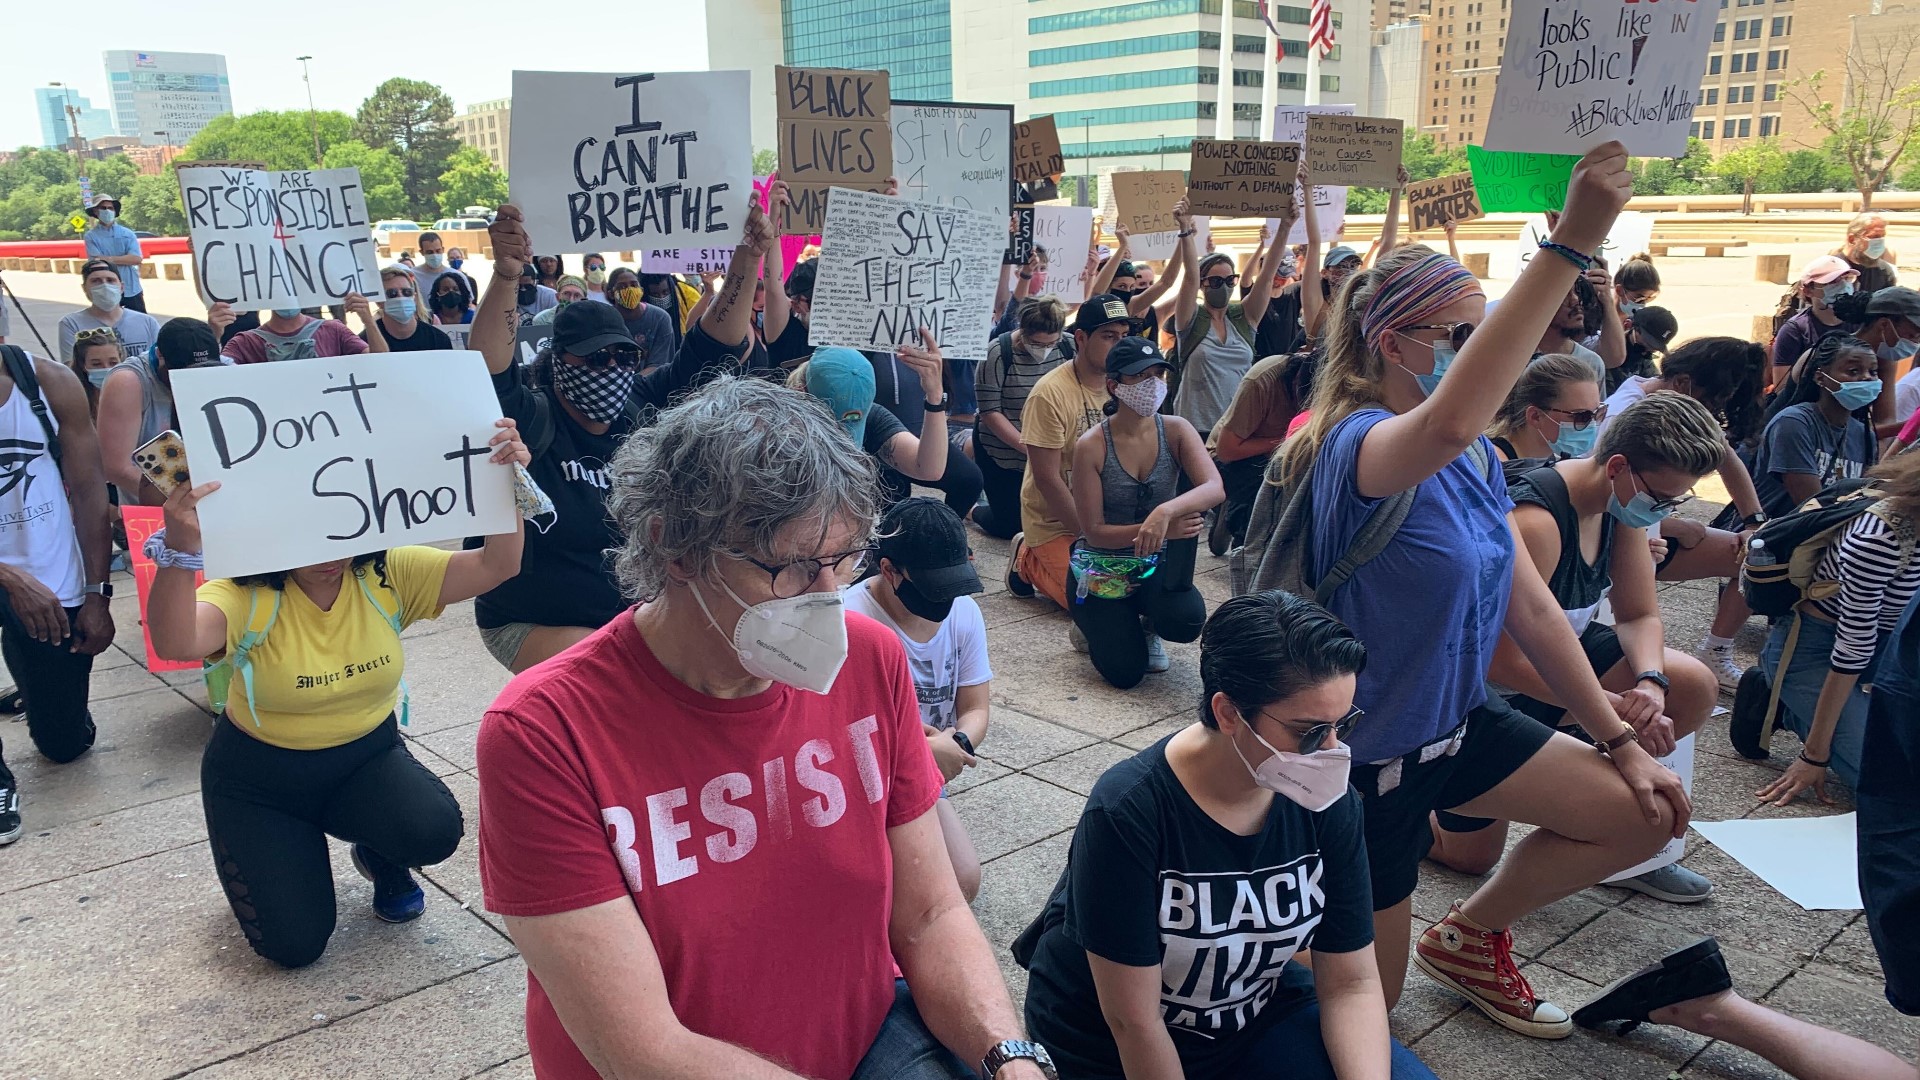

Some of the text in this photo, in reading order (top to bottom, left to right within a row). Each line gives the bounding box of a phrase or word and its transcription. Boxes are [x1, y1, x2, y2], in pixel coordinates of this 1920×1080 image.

[1540, 7, 1690, 48] looks like IN
[615, 73, 662, 137] I
[788, 71, 875, 117] BLACK
[1310, 117, 1398, 136] The thing Worse than
[1349, 137, 1357, 146] is
[1373, 139, 1393, 152] thing
[574, 131, 698, 191] CAN'T
[790, 123, 875, 174] LIVES
[1196, 143, 1240, 159] POWER
[1244, 144, 1299, 162] CONCEDES
[1337, 149, 1373, 160] Causes
[1472, 147, 1541, 178] VOTE
[220, 170, 314, 189] WE ARE
[906, 165, 928, 201] 4
[1224, 160, 1276, 176] NOTHING
[1133, 182, 1177, 197] JUSTICE
[1148, 199, 1160, 211] NO
[1191, 181, 1234, 192] WITHOUT
[1239, 181, 1249, 192] A
[1253, 180, 1294, 196] DEMAND
[1409, 175, 1474, 205] BLACK LIVE
[1477, 183, 1518, 206] TED
[186, 184, 365, 231] RESPONSIBLE
[568, 182, 729, 243] BREATHE
[1413, 190, 1479, 231] MATTER
[273, 214, 296, 249] 4
[897, 210, 956, 261] SAY
[201, 237, 380, 304] CHANGE
[651, 248, 680, 259] ARE
[853, 256, 962, 305] THEIR
[870, 304, 958, 349] NAME
[200, 373, 377, 469] Don't
[312, 434, 492, 540] Shoot
[295, 654, 391, 690] Mujer Fuerte
[932, 688, 940, 696] of
[601, 714, 883, 893] RESIST
[1158, 858, 1326, 934] BLACK
